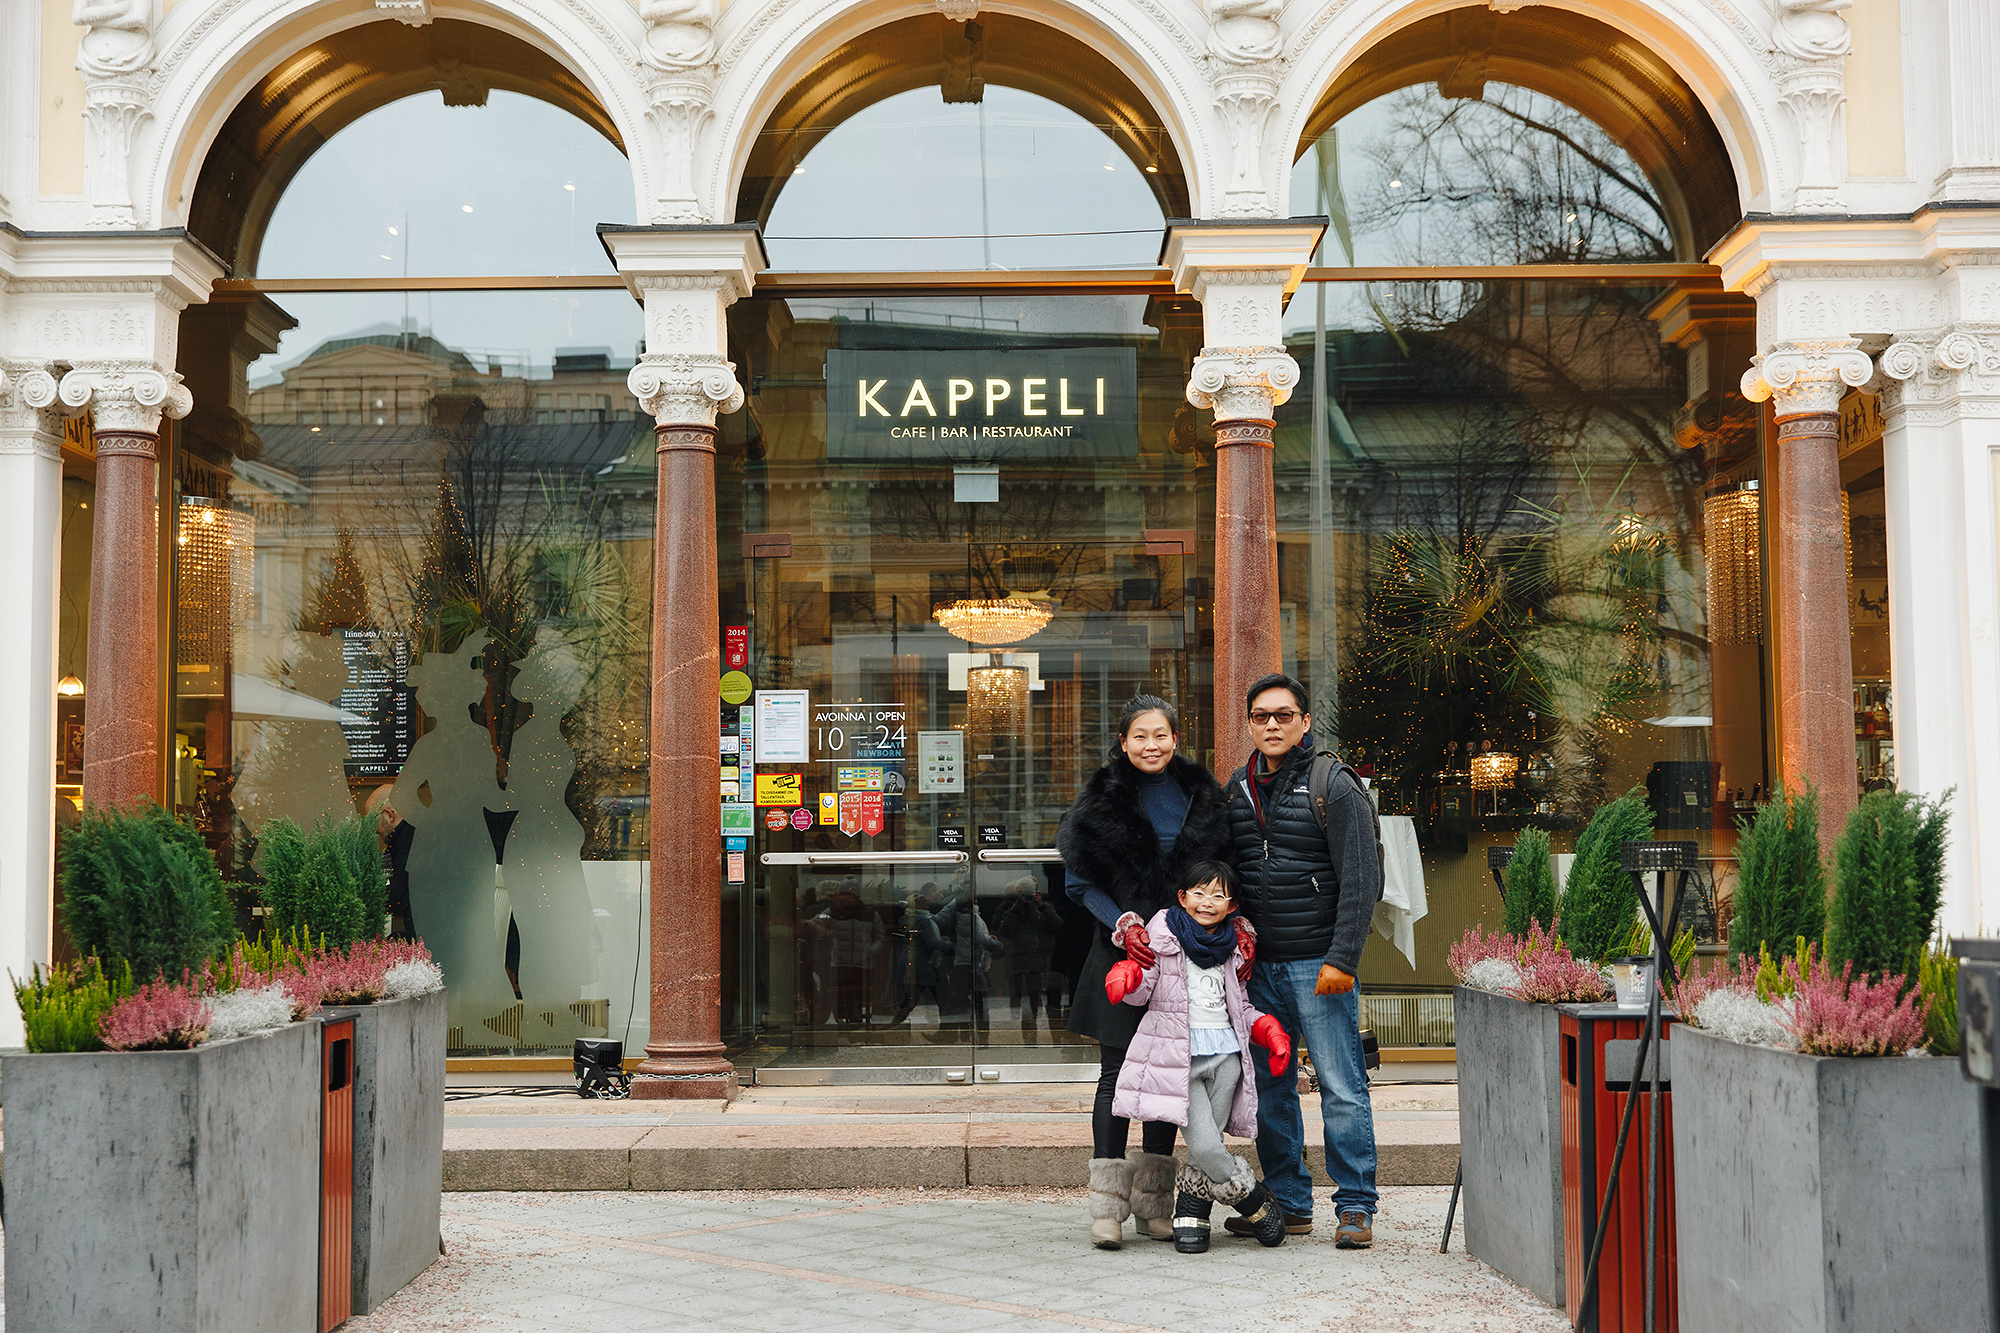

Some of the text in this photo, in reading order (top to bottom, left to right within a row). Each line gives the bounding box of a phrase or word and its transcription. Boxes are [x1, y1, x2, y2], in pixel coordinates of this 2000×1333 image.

[858, 377, 1105, 417] KAPPELI
[890, 426, 927, 438] CAFE
[940, 426, 969, 438] BAR
[982, 426, 1074, 438] RESTAURANT
[347, 458, 420, 486] EST.
[815, 712, 866, 722] AVOINNA
[875, 711, 906, 721] OPEN
[818, 726, 844, 751] 10
[875, 724, 908, 749] 24
[856, 749, 902, 757] NEWBORN
[842, 793, 860, 803] 2015
[863, 793, 882, 803] 2016
